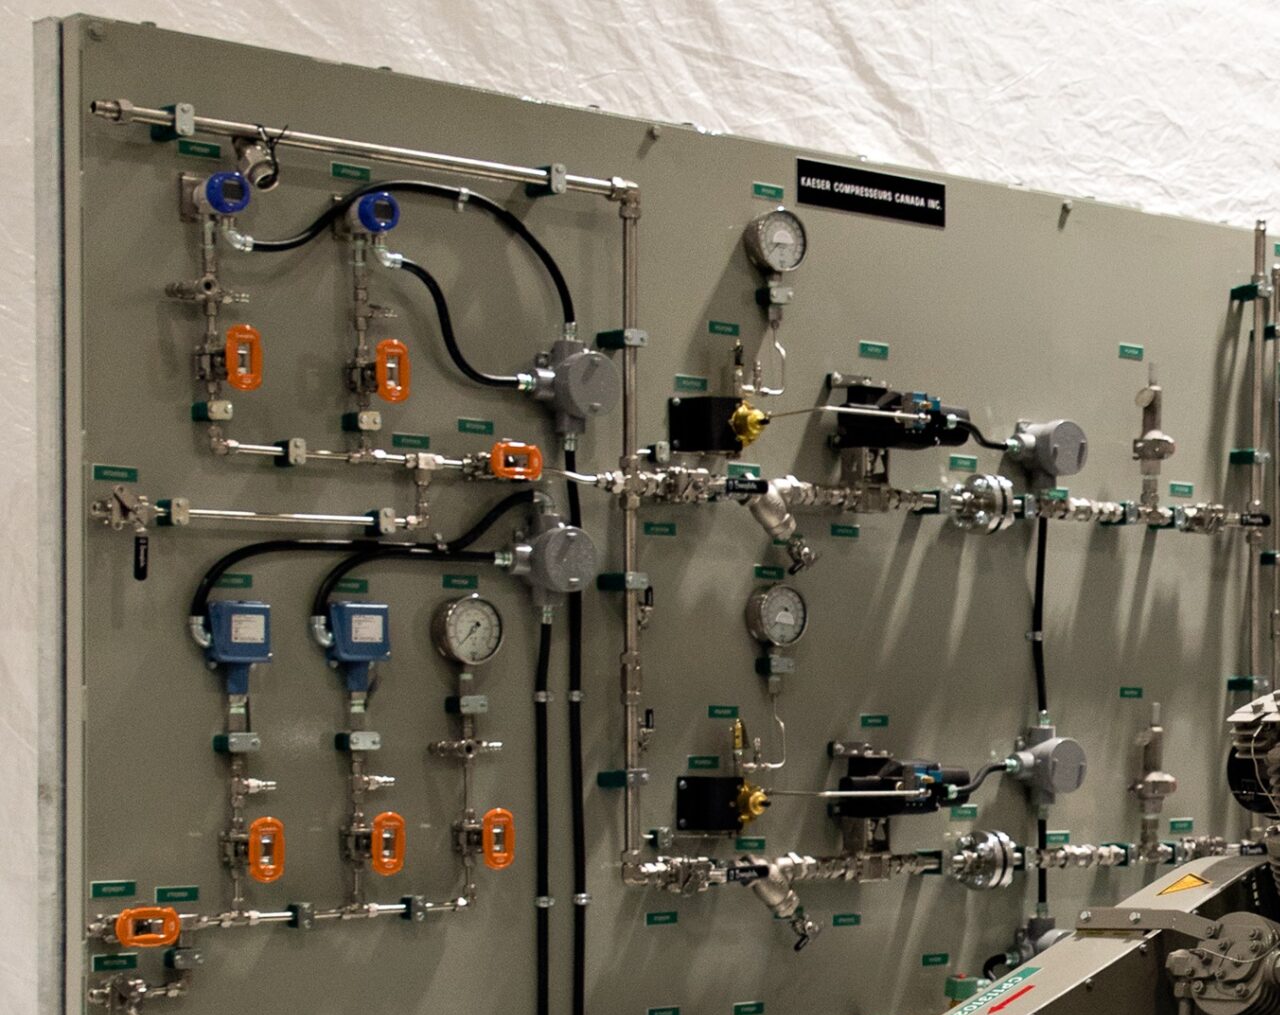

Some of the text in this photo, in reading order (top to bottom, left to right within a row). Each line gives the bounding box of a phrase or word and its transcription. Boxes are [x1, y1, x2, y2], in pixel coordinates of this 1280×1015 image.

[800, 176, 943, 210] KAESER COMPRESSEURS CANADA INC.
